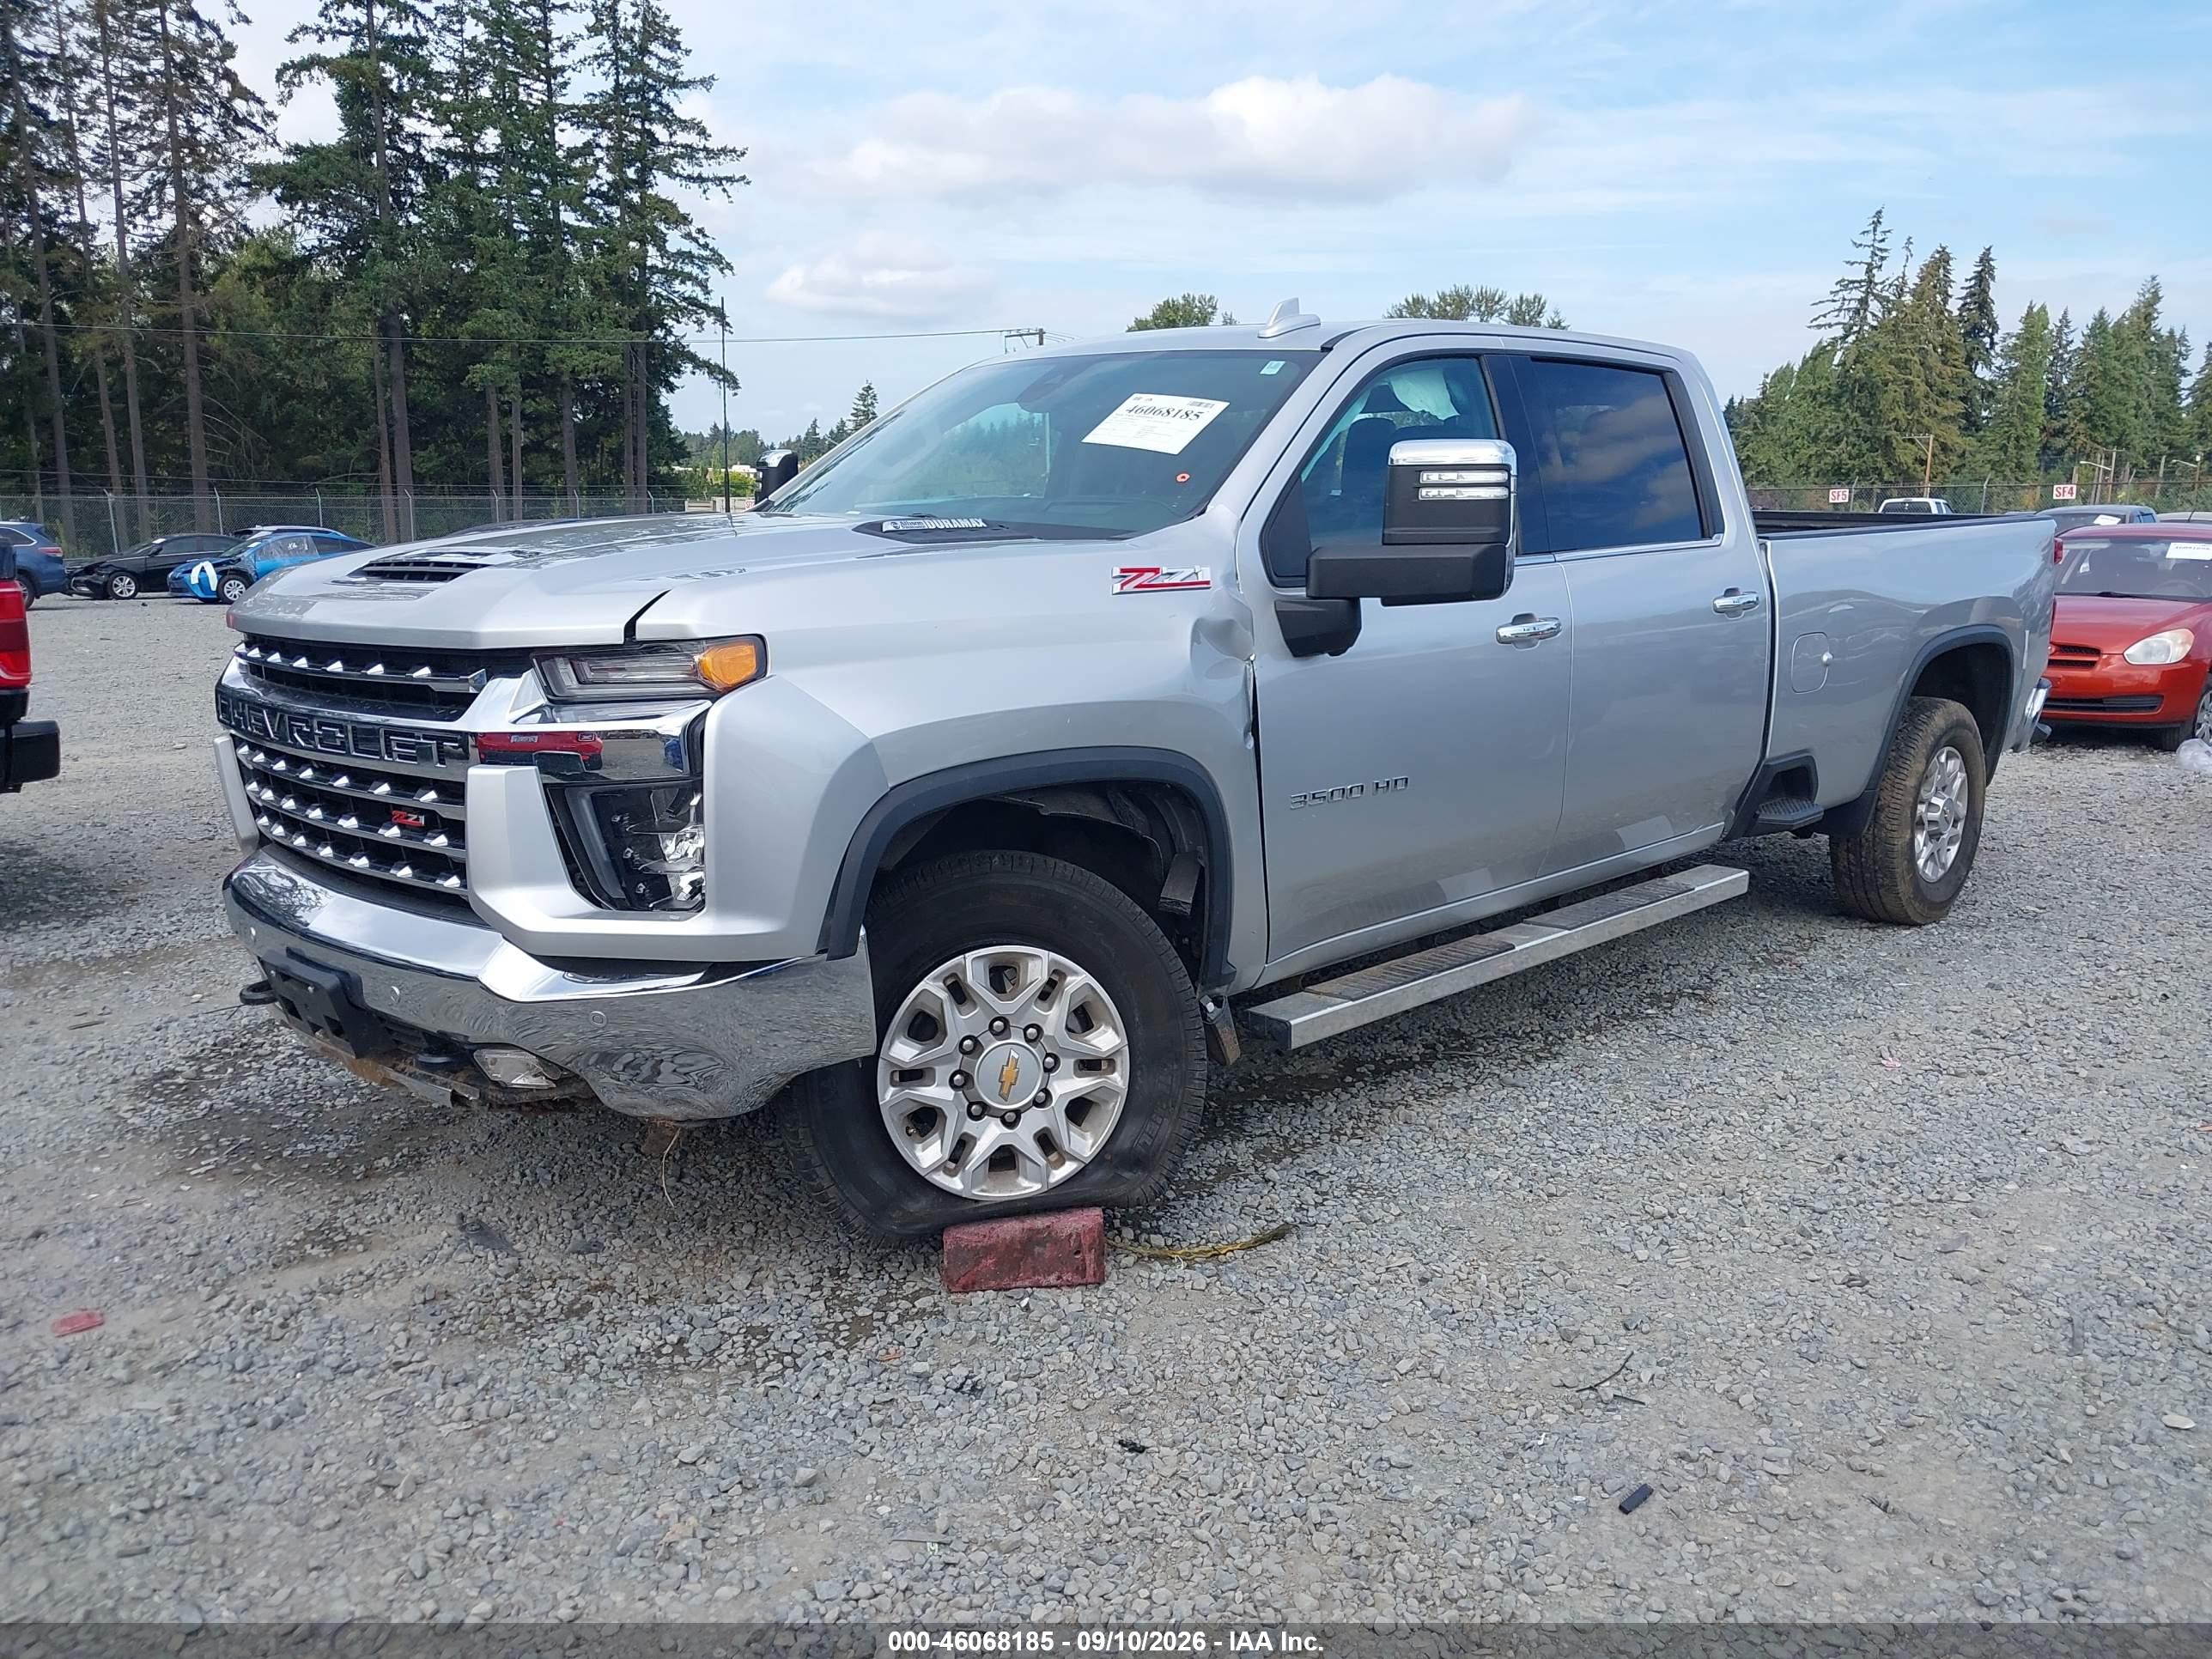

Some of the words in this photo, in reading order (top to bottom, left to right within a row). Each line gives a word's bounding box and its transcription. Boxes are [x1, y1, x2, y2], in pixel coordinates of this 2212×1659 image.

[1126, 404, 1205, 421] 46068185
[1831, 490, 1848, 501] SF5
[2055, 486, 2074, 497] SF4
[925, 519, 988, 529] DURAMAX
[1111, 565, 1212, 595] Z71
[218, 693, 469, 768] CHEVROLET
[1291, 782, 1364, 810] 3500
[1372, 775, 1409, 795] HD
